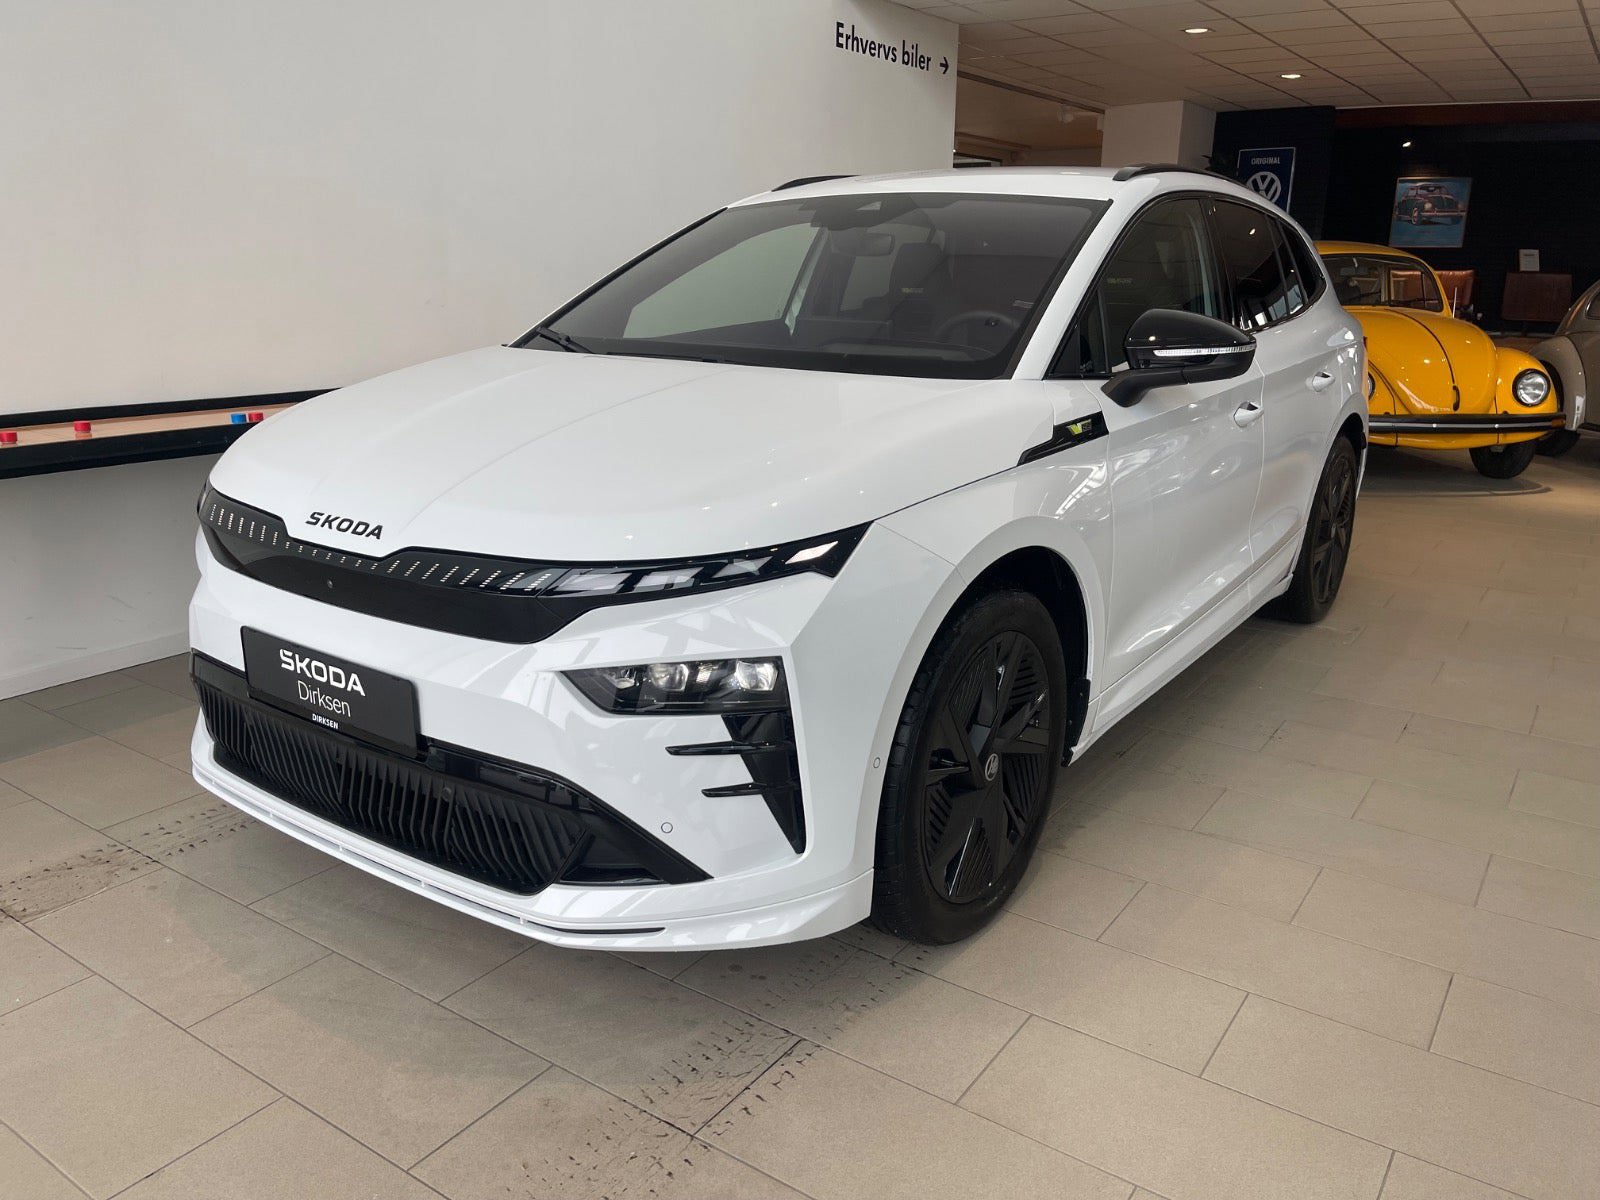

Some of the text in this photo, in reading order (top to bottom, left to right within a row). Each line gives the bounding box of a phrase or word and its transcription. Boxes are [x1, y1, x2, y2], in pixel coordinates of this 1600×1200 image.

[836, 21, 931, 71] Erhvervs biler
[1250, 157, 1281, 166] ORIGINAL
[297, 680, 351, 717] Dirksen
[312, 713, 339, 729] DIRKSEN
